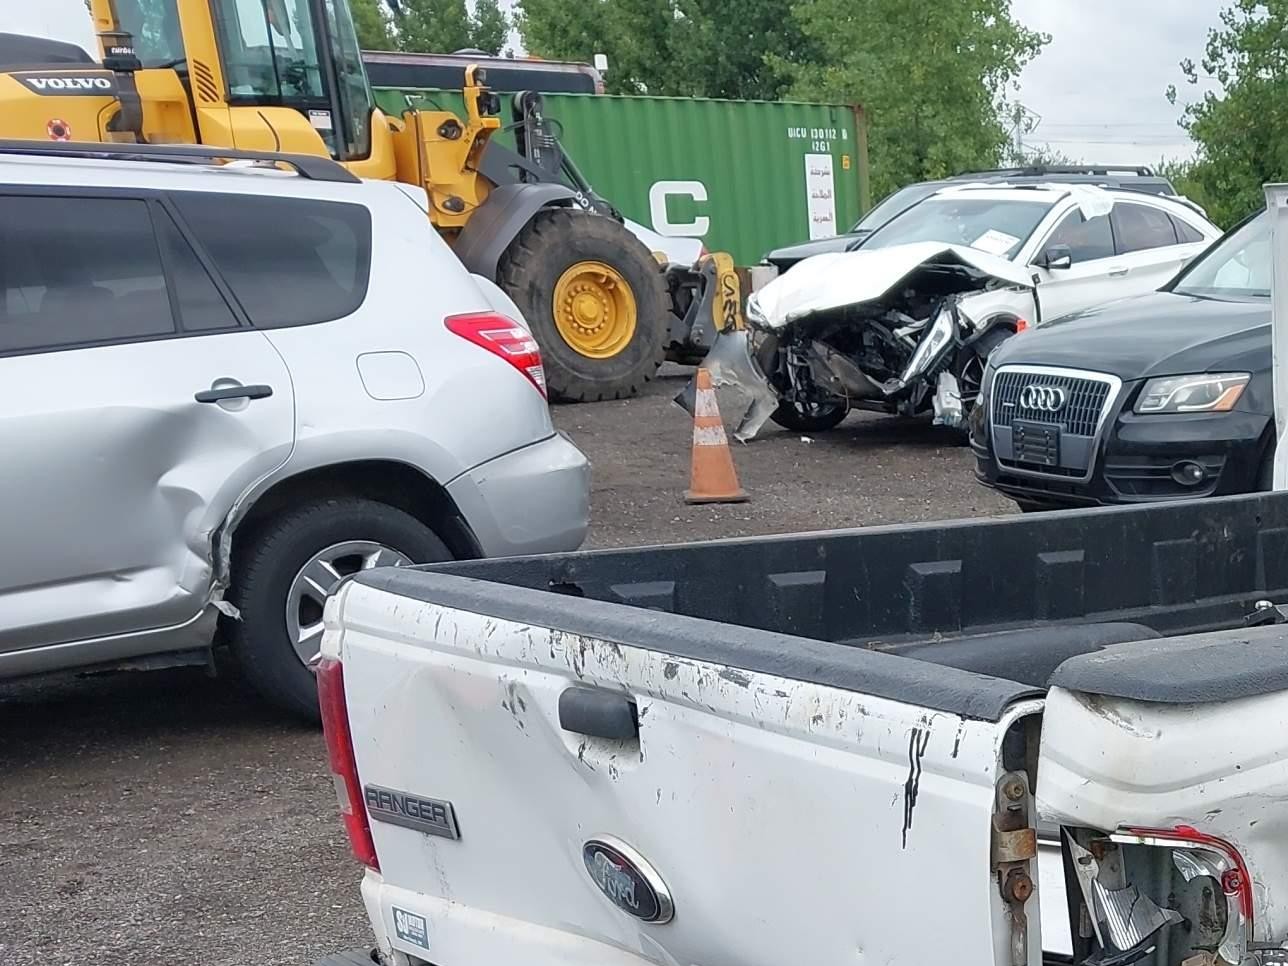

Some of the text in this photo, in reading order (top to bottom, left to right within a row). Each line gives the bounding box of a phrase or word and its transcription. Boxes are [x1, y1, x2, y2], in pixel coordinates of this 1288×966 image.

[26, 78, 111, 89] VOLVO
[365, 788, 448, 825] RANGER
[594, 851, 640, 909] Ford
